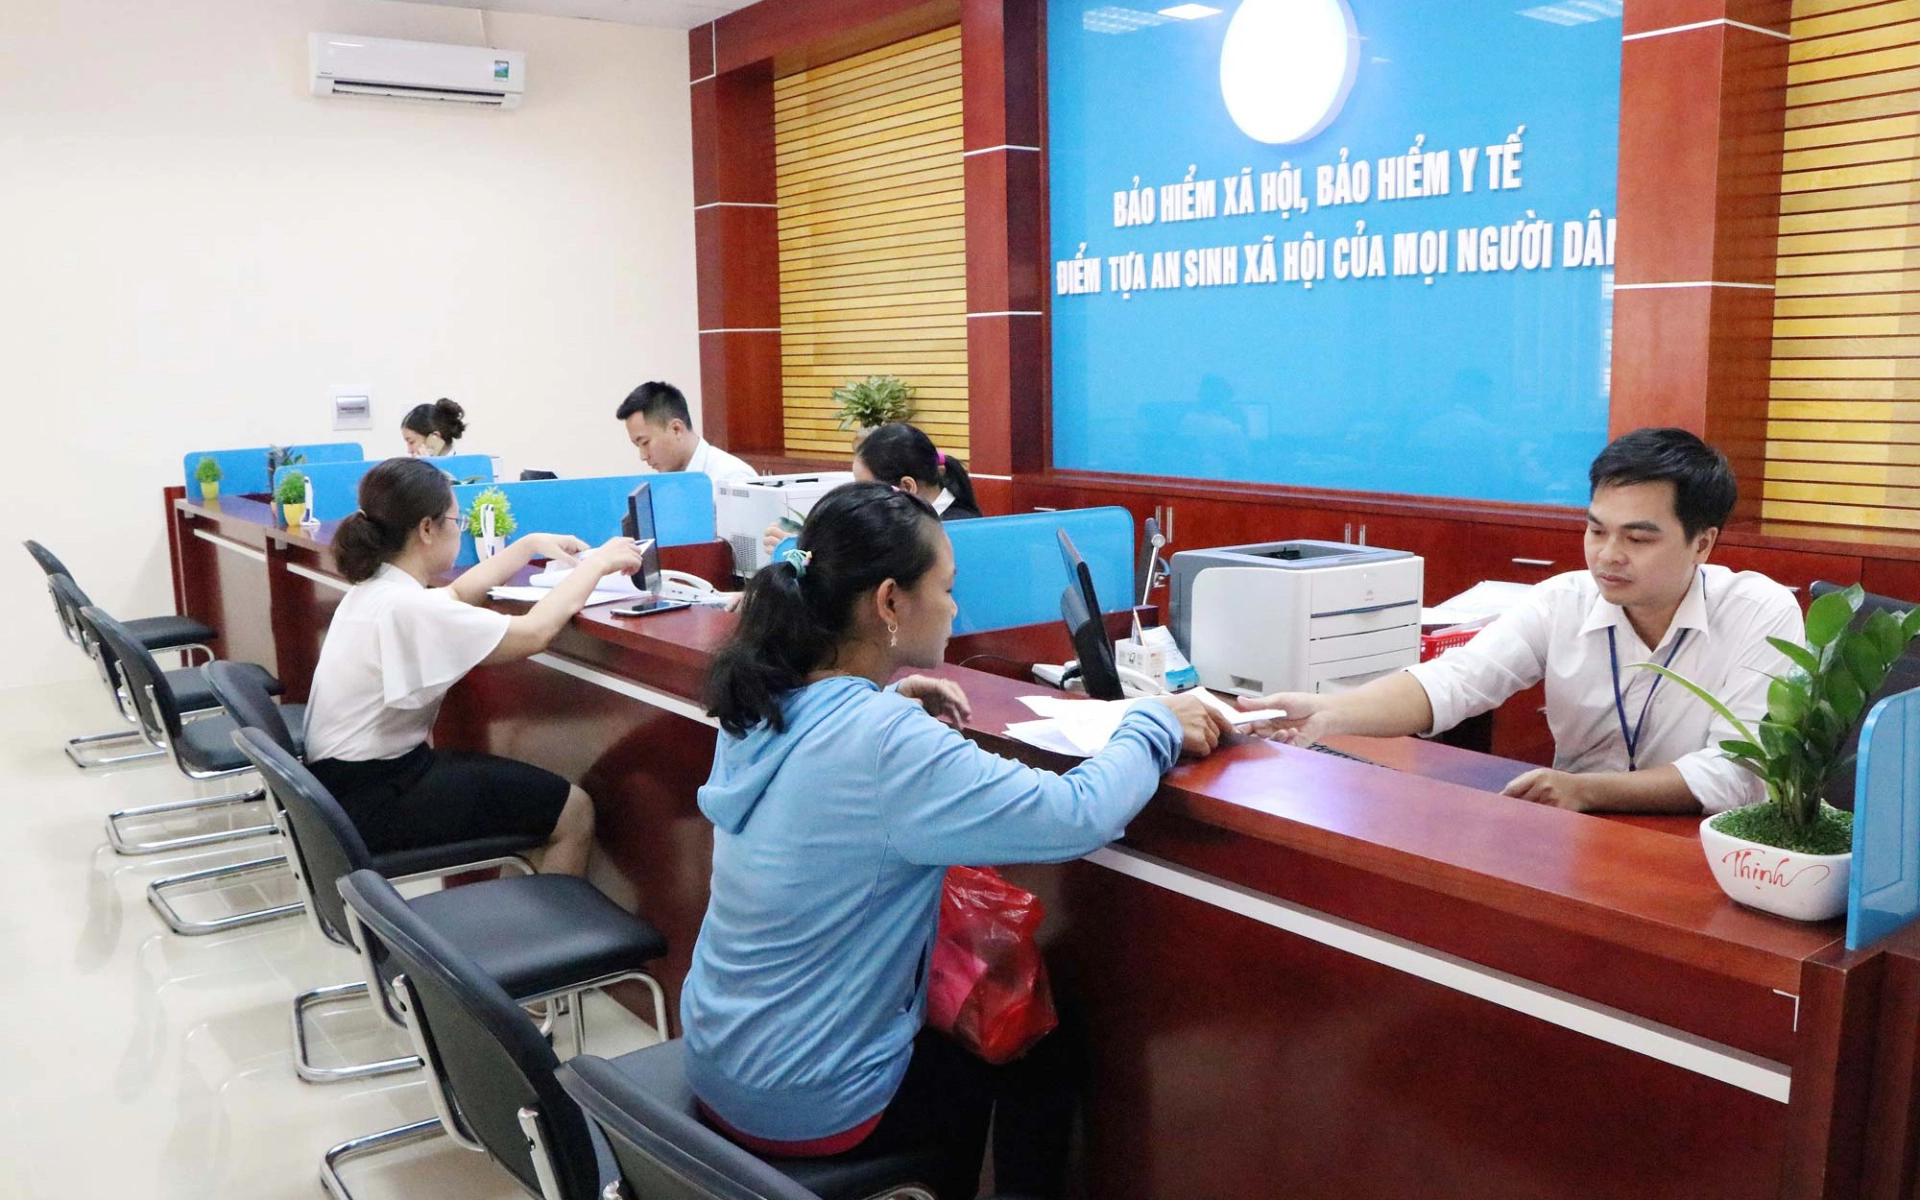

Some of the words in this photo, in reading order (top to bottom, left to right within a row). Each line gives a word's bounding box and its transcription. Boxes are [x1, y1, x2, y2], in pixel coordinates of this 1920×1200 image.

[1113, 175, 1156, 228] BẢO
[1160, 163, 1217, 223] HIỂM
[1223, 167, 1256, 216] XÃ
[1261, 161, 1309, 219] HỘI,
[1317, 147, 1371, 207] BẢO
[1378, 133, 1450, 201] HIỂM
[1458, 147, 1480, 193] Y
[1486, 125, 1526, 190] TẾ
[1056, 242, 1101, 296] ĐIỂM
[1108, 251, 1148, 300] TỰA
[1151, 251, 1181, 289] AN
[1184, 246, 1238, 288] SINH
[1243, 235, 1278, 284] XÃ
[1283, 231, 1327, 290] HỘI
[1333, 220, 1388, 280] CỦA
[1393, 228, 1449, 285] MỌI
[1457, 209, 1554, 274] NGƯỜI
